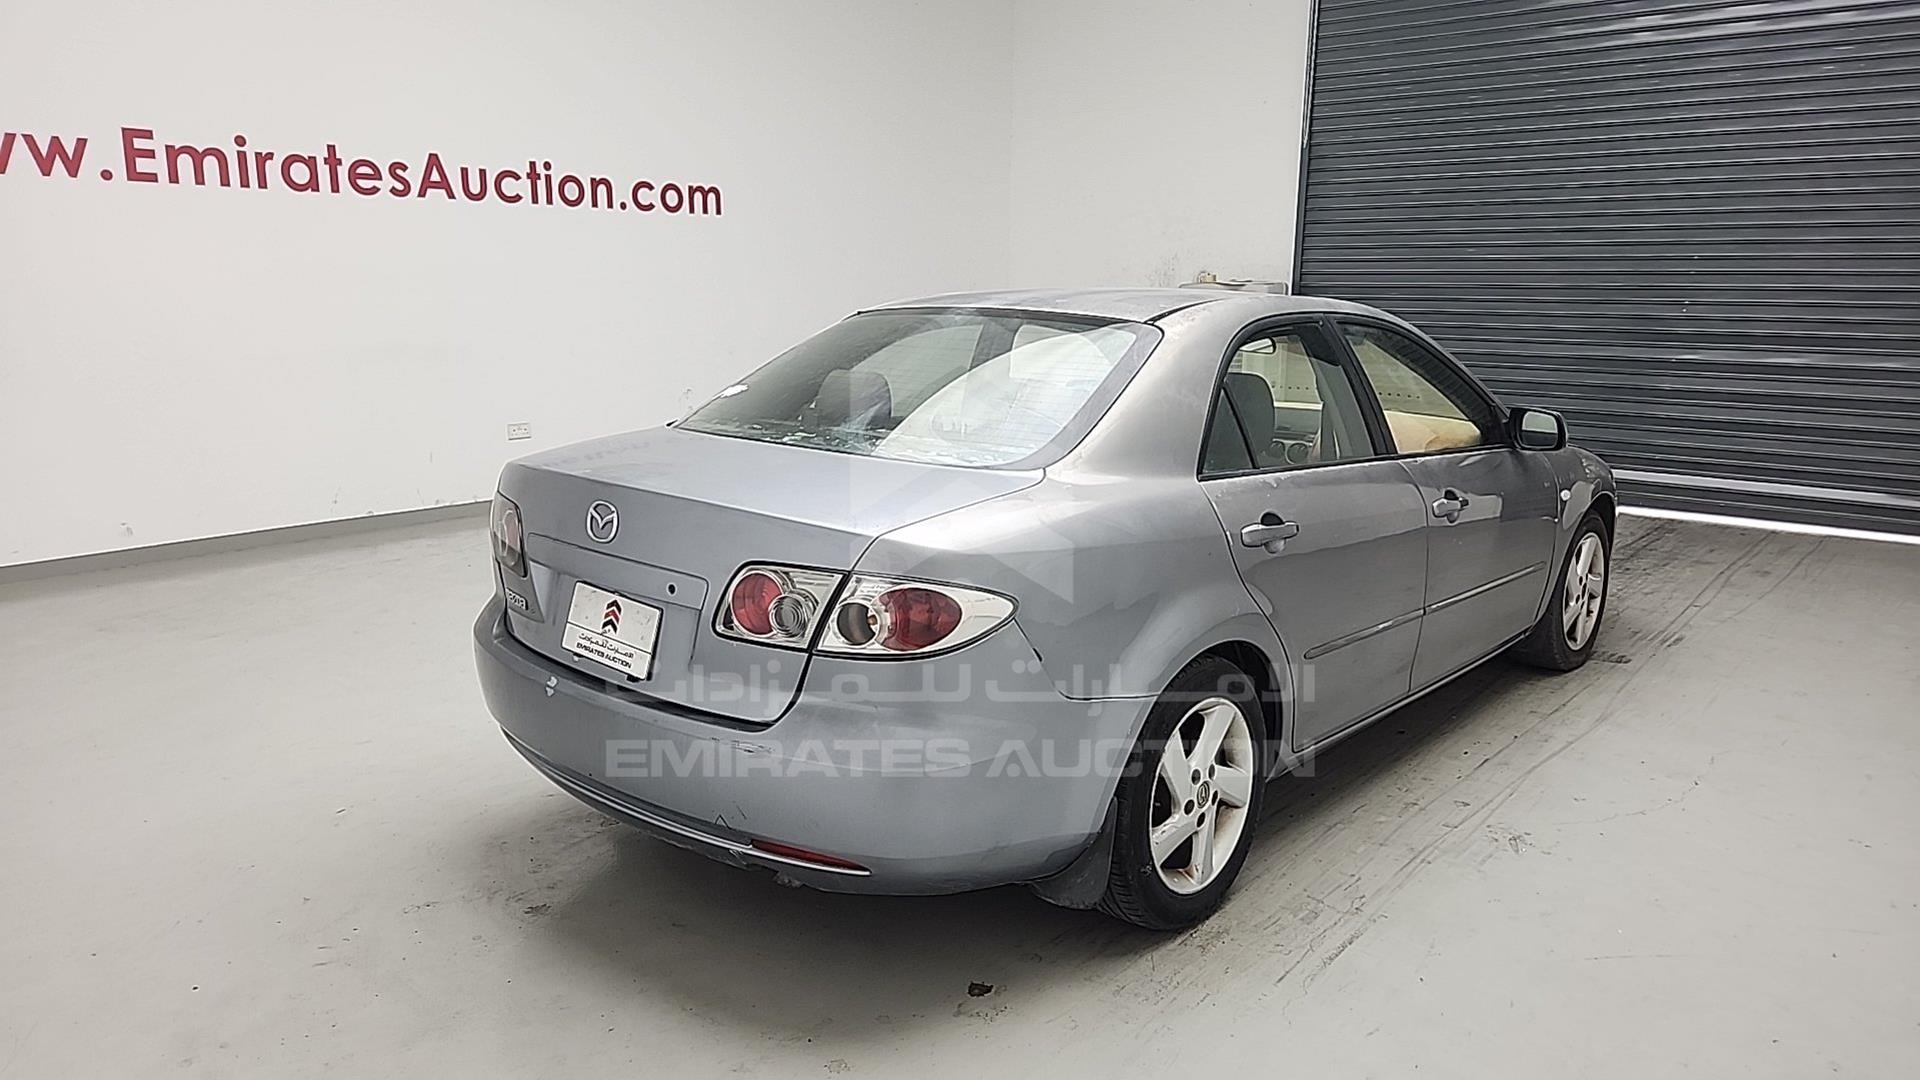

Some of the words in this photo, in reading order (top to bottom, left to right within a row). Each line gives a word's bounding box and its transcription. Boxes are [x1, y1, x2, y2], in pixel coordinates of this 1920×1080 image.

[0, 127, 723, 216] w.EmiratesAuction.com
[576, 642, 605, 658] EMIRATES
[604, 655, 632, 669] AUCTION
